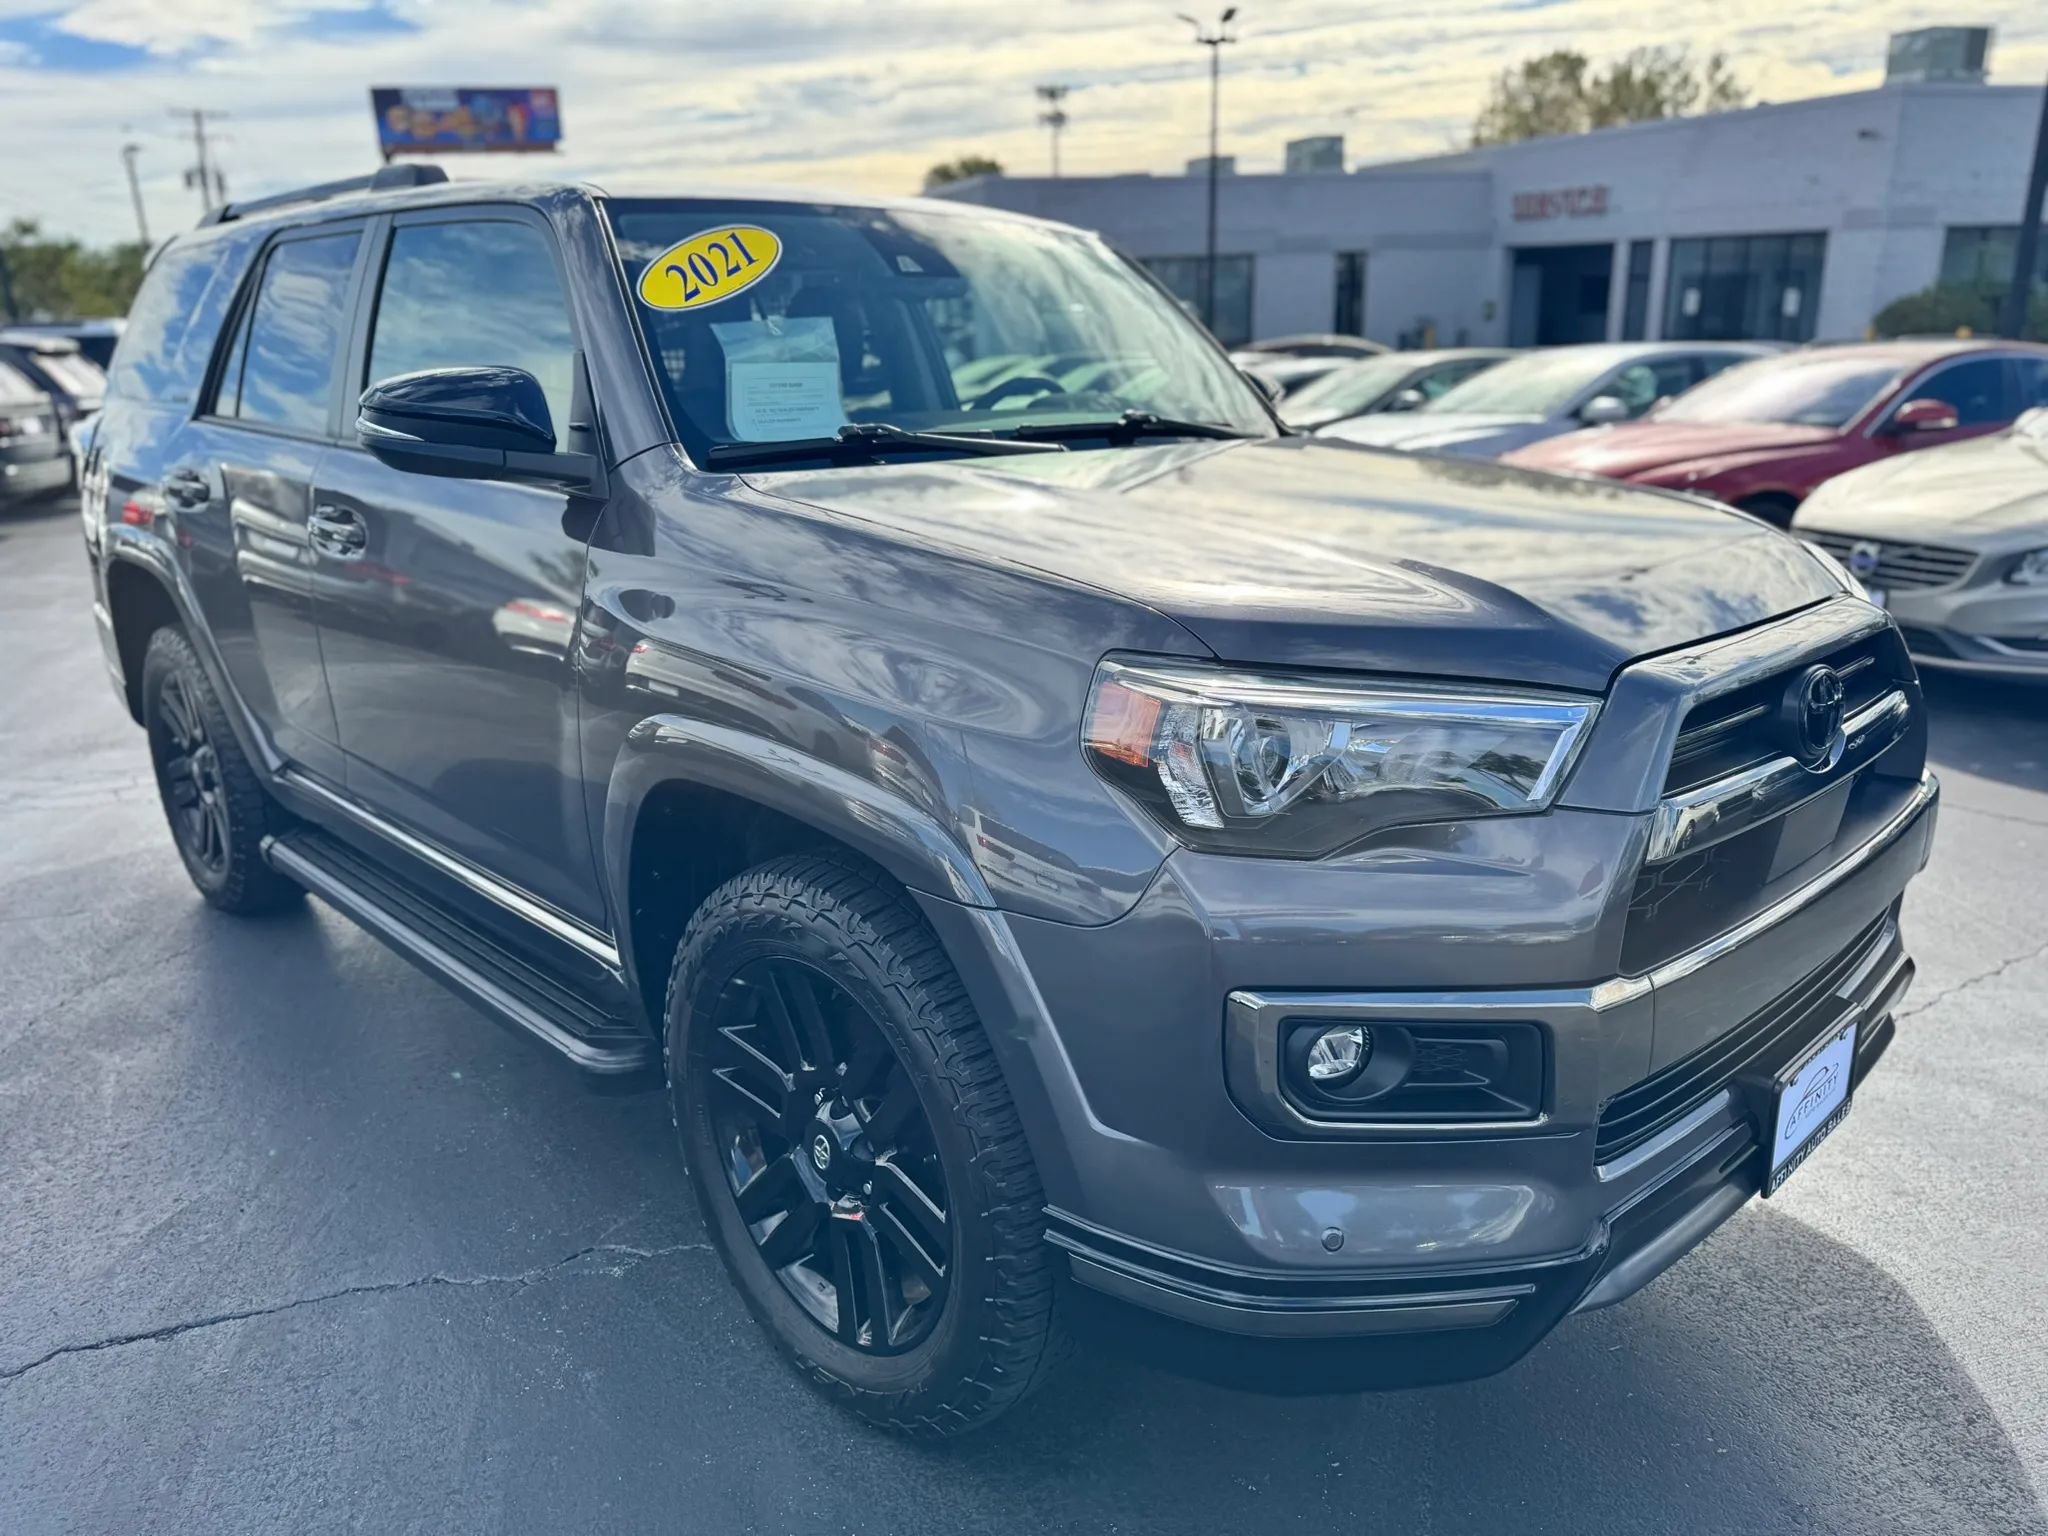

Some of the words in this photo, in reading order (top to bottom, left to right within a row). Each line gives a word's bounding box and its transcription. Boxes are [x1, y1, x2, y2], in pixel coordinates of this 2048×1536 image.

[665, 232, 760, 302] 2021
[1790, 1075, 1838, 1126] AFFINITY
[1771, 1151, 1807, 1192] AFFINITY
[1806, 1128, 1826, 1155] AUTO
